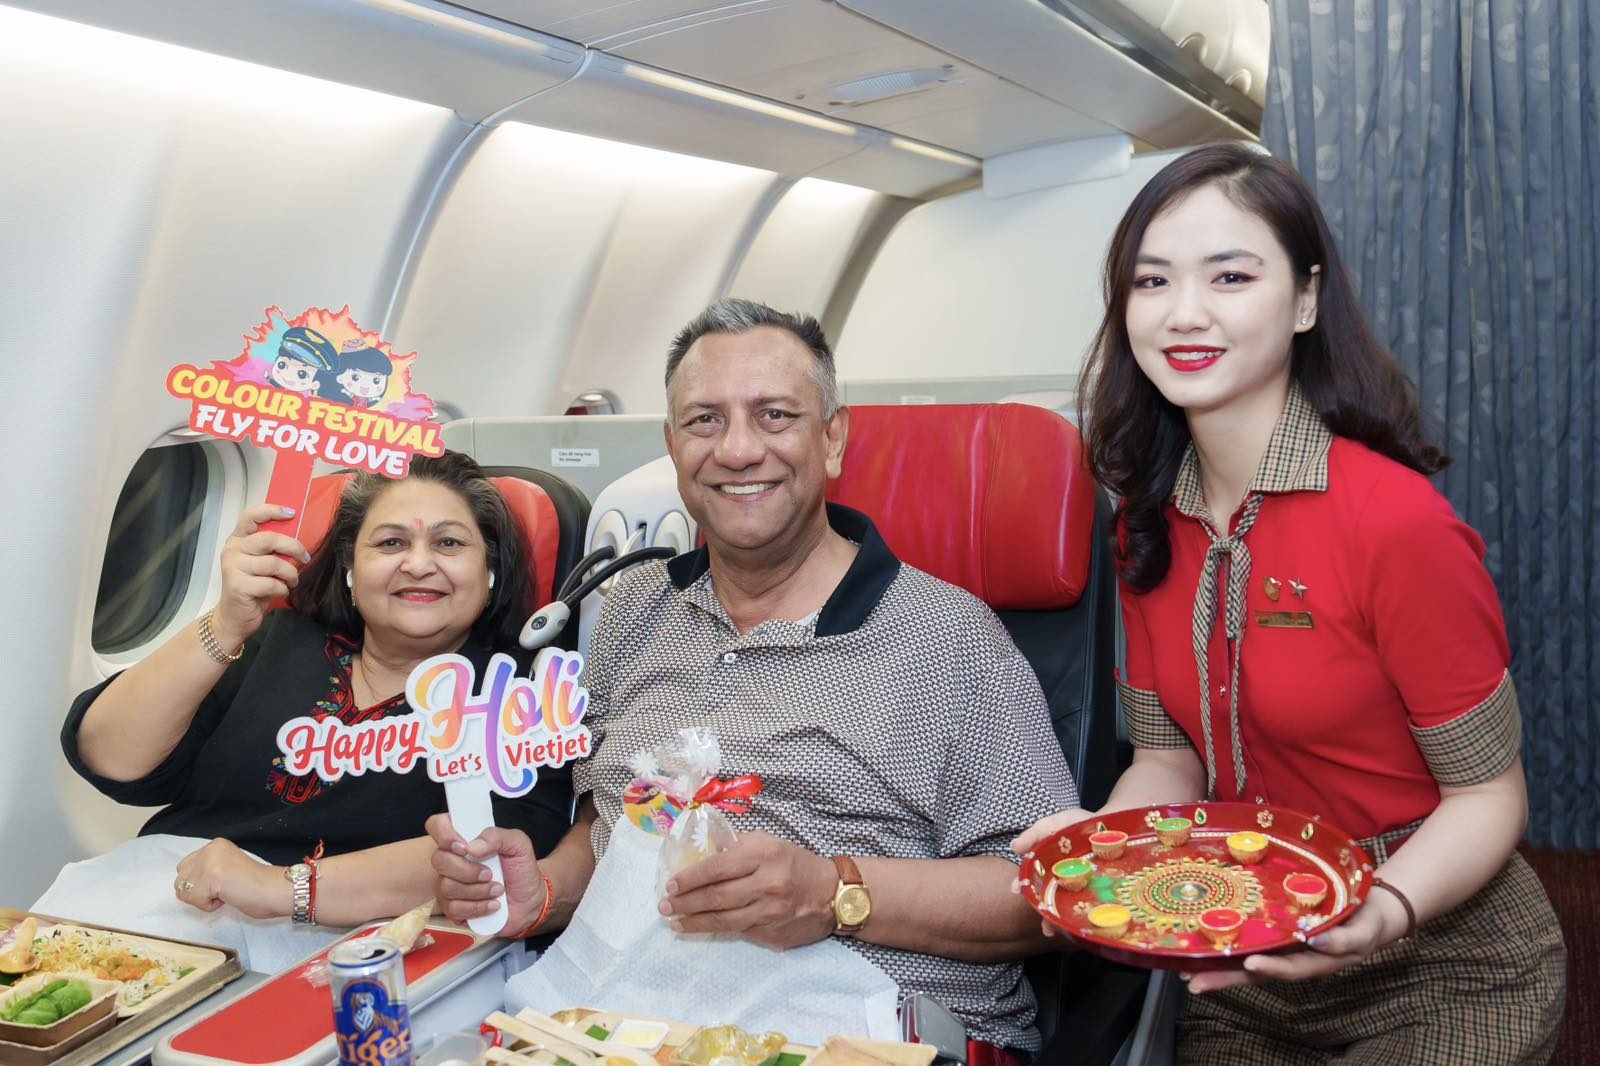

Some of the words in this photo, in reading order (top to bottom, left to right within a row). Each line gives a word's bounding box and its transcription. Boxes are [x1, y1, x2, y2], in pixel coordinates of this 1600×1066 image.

[172, 369, 303, 420] COLOUR
[307, 401, 442, 455] FESTIVAL
[195, 405, 255, 437] FLY
[256, 419, 320, 456] FOR
[324, 437, 408, 475] LOVE
[286, 721, 428, 776] Happy
[415, 655, 586, 793] Holi
[435, 753, 482, 778] Let's
[505, 731, 589, 767] Vietjet
[337, 1029, 410, 1066] Tiger
